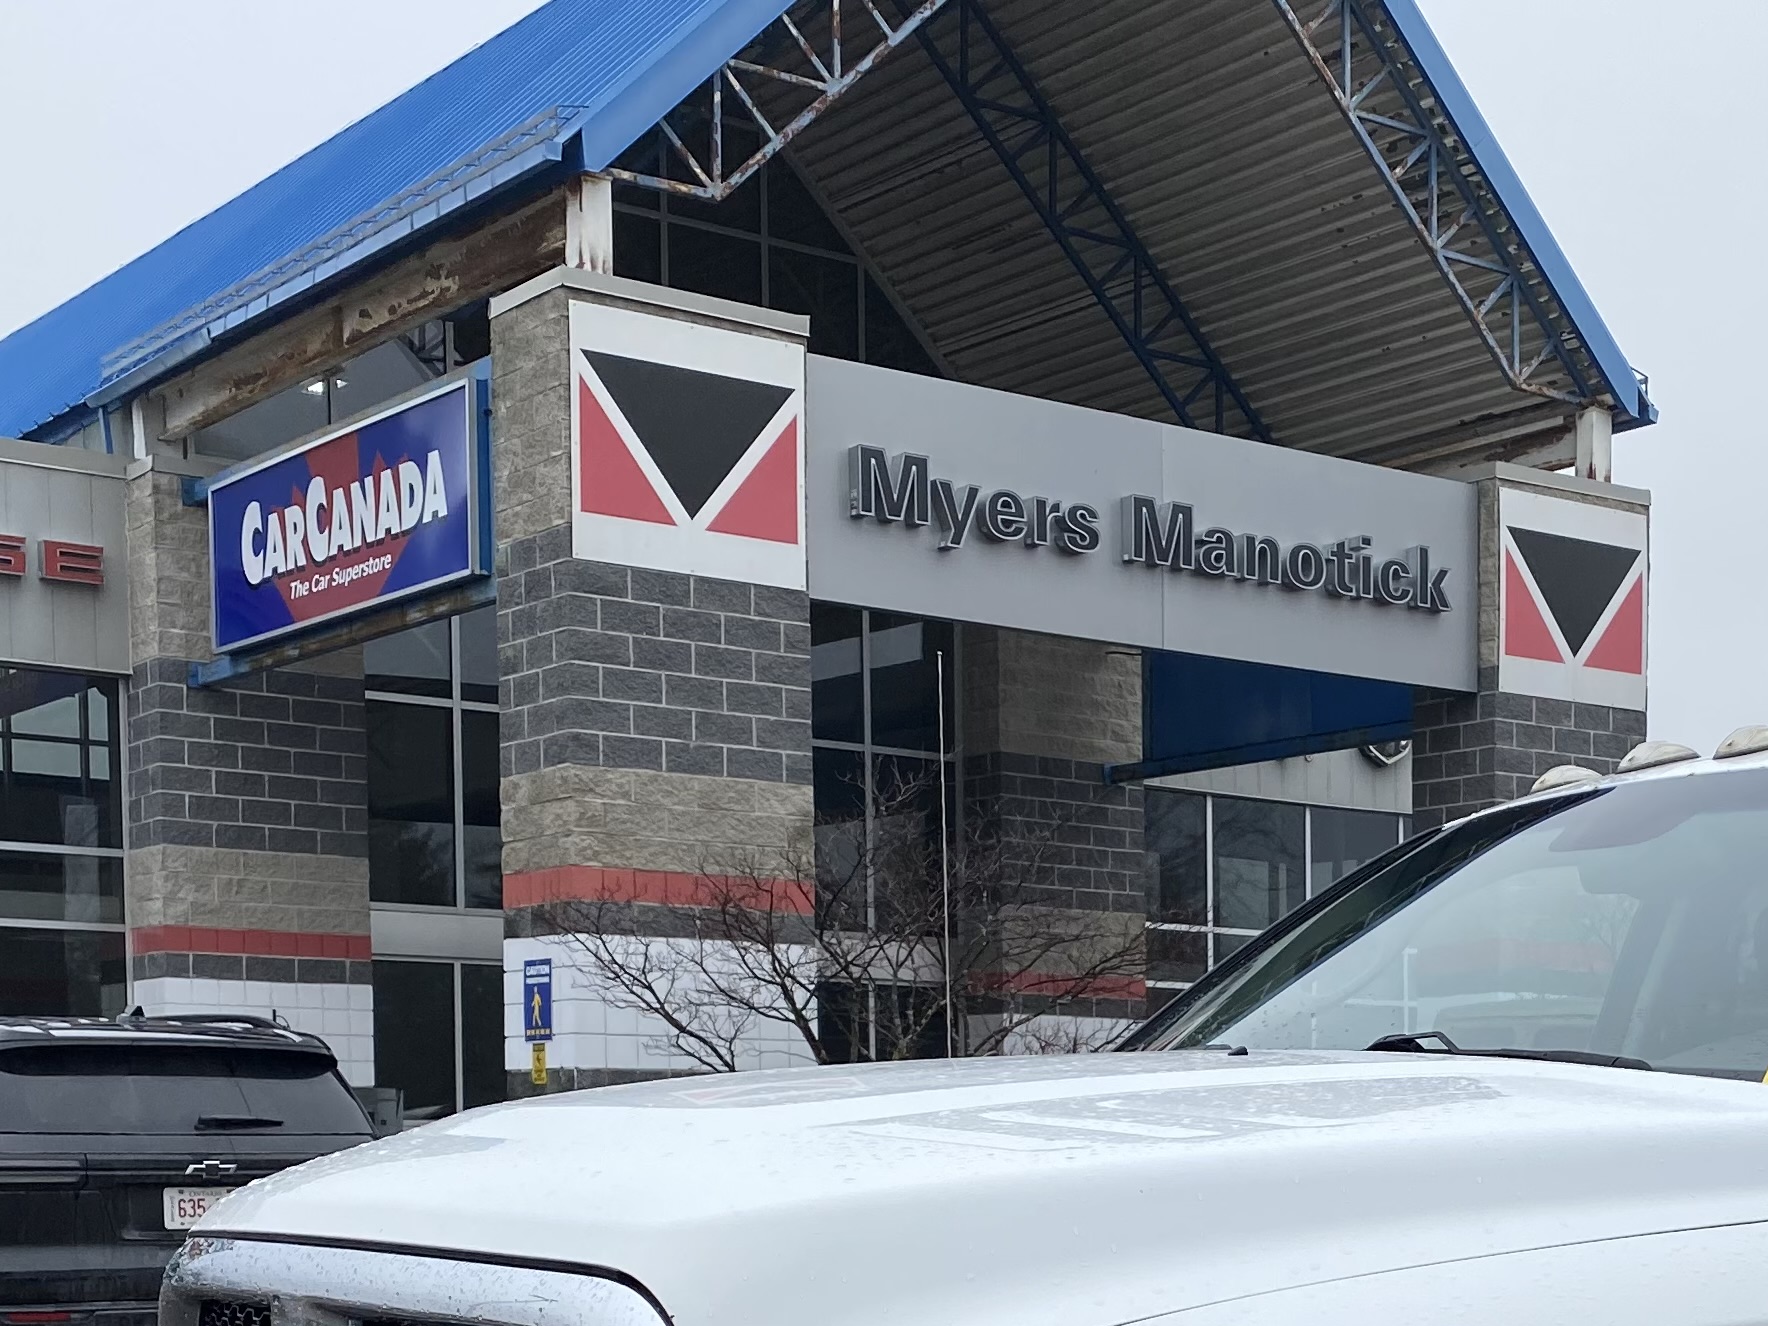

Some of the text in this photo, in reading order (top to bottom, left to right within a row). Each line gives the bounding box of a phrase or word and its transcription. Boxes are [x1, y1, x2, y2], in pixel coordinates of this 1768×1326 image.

[290, 553, 392, 600] The Car Superstore
[849, 443, 1452, 612] Myers Manotick
